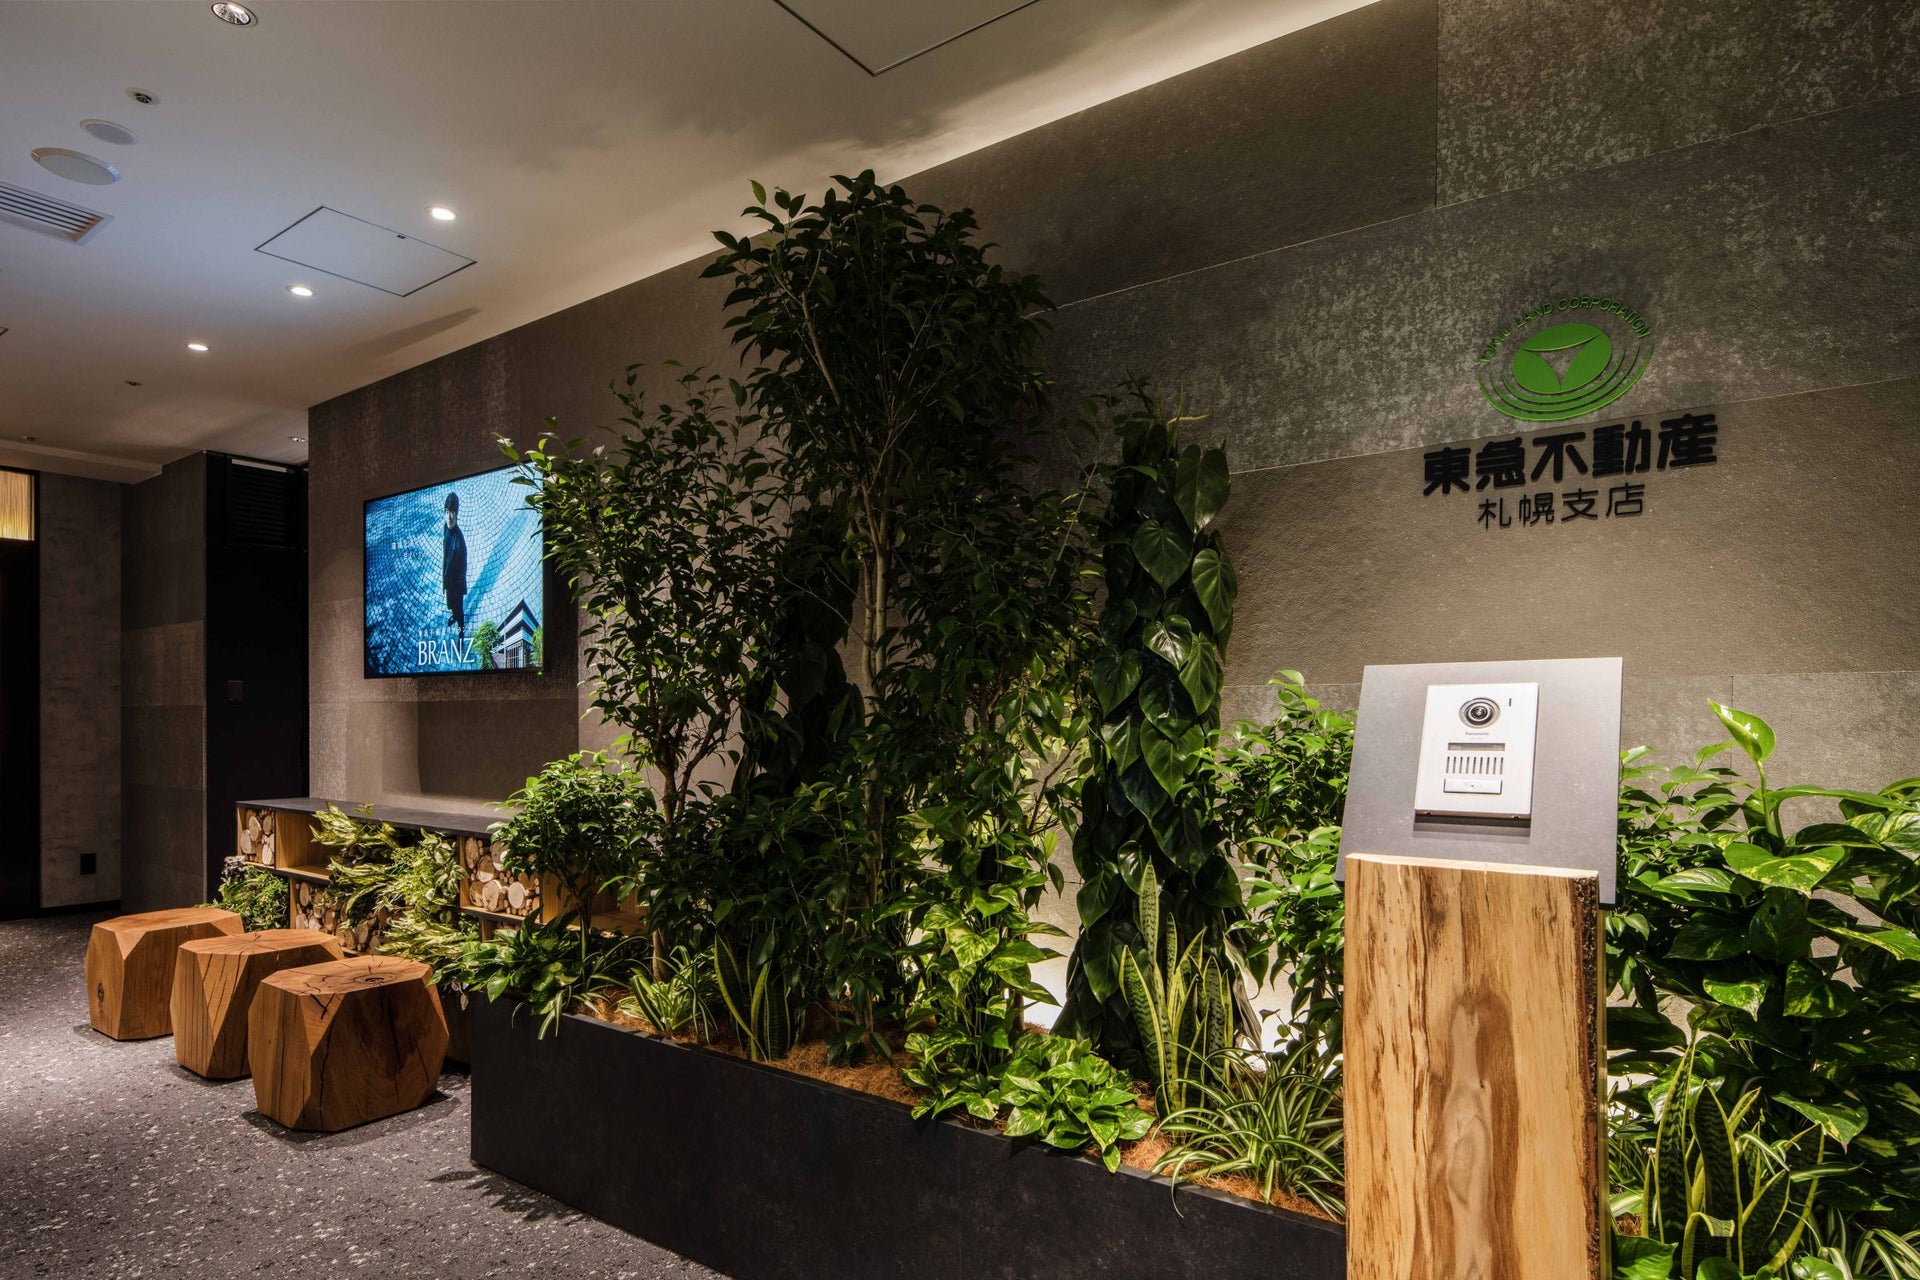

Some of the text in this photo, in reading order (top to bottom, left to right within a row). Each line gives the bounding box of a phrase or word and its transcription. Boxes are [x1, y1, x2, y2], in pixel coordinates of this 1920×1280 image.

[1514, 302, 1554, 329] LAND
[1557, 296, 1651, 340] CORPORATION
[1422, 413, 1719, 497] 東急不動産
[1477, 482, 1646, 532] 札幌支店
[418, 638, 475, 666] BRANZ
